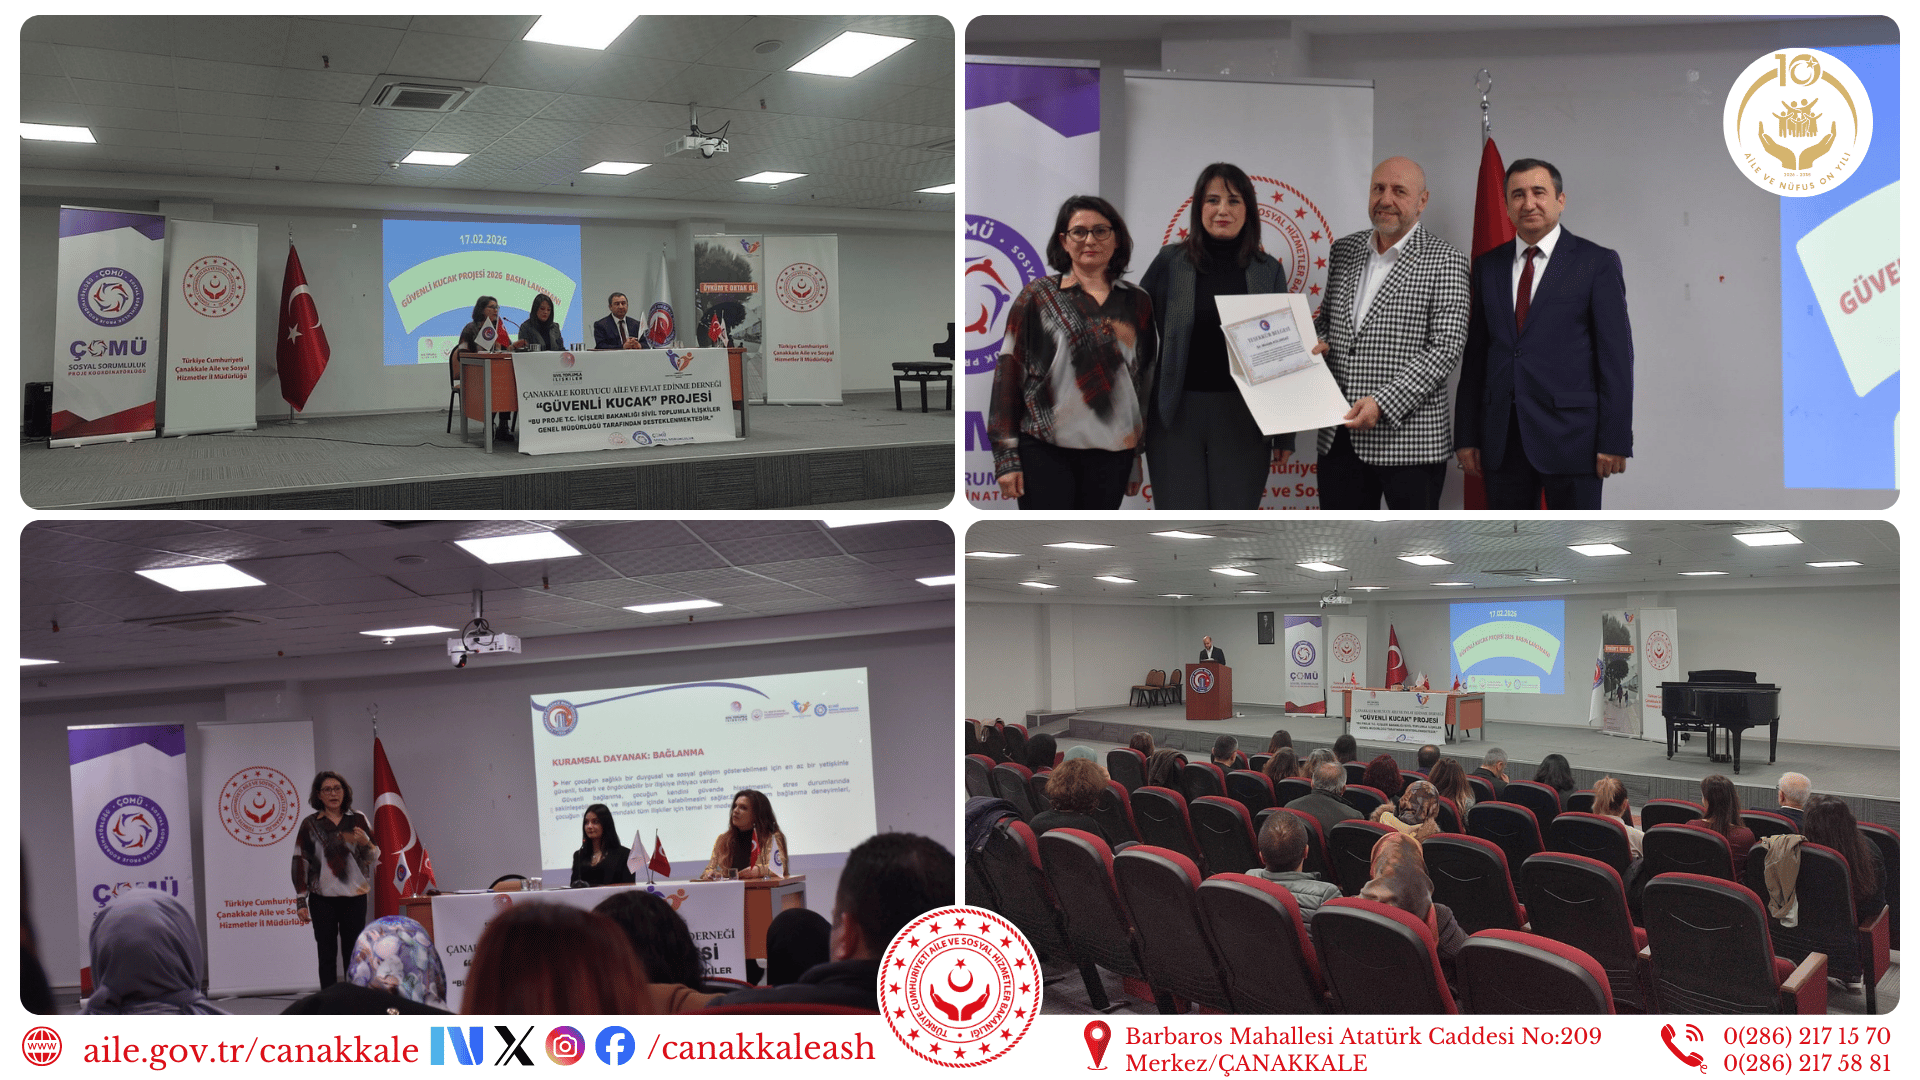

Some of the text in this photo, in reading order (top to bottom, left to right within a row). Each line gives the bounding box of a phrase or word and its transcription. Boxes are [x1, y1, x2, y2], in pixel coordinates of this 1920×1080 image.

[965, 220, 995, 239] MÜ
[459, 234, 507, 246] 17.02.2026
[1259, 208, 1285, 228] OSYAL
[1285, 224, 1306, 278] HİZMETLER
[1010, 245, 1037, 283] SOSYA
[99, 269, 123, 277] ÇOMÜ
[401, 282, 432, 308] GÜVENLİ
[432, 274, 458, 290] KUCAK
[458, 268, 485, 281] PROJESİ
[486, 271, 503, 280] 2026
[505, 273, 527, 286] BASIN
[1839, 258, 1900, 314] GÜVE
[70, 336, 147, 361] ÇOMÜ
[98, 362, 146, 370] SORUMLULUK
[230, 365, 249, 373] Sosyal
[214, 372, 247, 380] Müdürlüğü
[523, 380, 722, 400] ÇANAKKALE KORUYUCU AİLE VE EVLAT EDİNME DERNEĞİ
[536, 390, 712, 413] “GÜVENLİ KUCAK” PROJESİ
[542, 416, 563, 424] PROJE
[577, 413, 605, 422] İÇİŞLERİ
[606, 410, 640, 419] BAKANLIĞI
[641, 409, 657, 417] SİVİL
[692, 406, 721, 414] İLİŞKİLER
[538, 426, 560, 434] GENEL
[561, 422, 601, 432] MÜDÜRLÜĞÜ
[603, 421, 642, 429] TARAFINDAN
[1272, 487, 1291, 497] ve
[1290, 671, 1319, 681] ÇOMÜ
[1413, 716, 1439, 724] PROJESİ
[552, 748, 704, 767] KURAMSAL DAYANAK: BAĞLANMA
[574, 778, 599, 786] çocuğun
[637, 773, 663, 782] duygusal
[699, 769, 720, 777] gelişim
[723, 766, 768, 775] gösterebilmesi
[819, 759, 849, 768] yetişkinle
[633, 791, 657, 799] çocuğun
[698, 786, 724, 794] güvende
[117, 797, 143, 807] ÇOMÜ
[224, 897, 298, 908] Türkiye Cumhuriye
[217, 910, 257, 920] Çanakkale
[259, 909, 274, 917] Aile
[219, 920, 258, 929] Hizmetler
